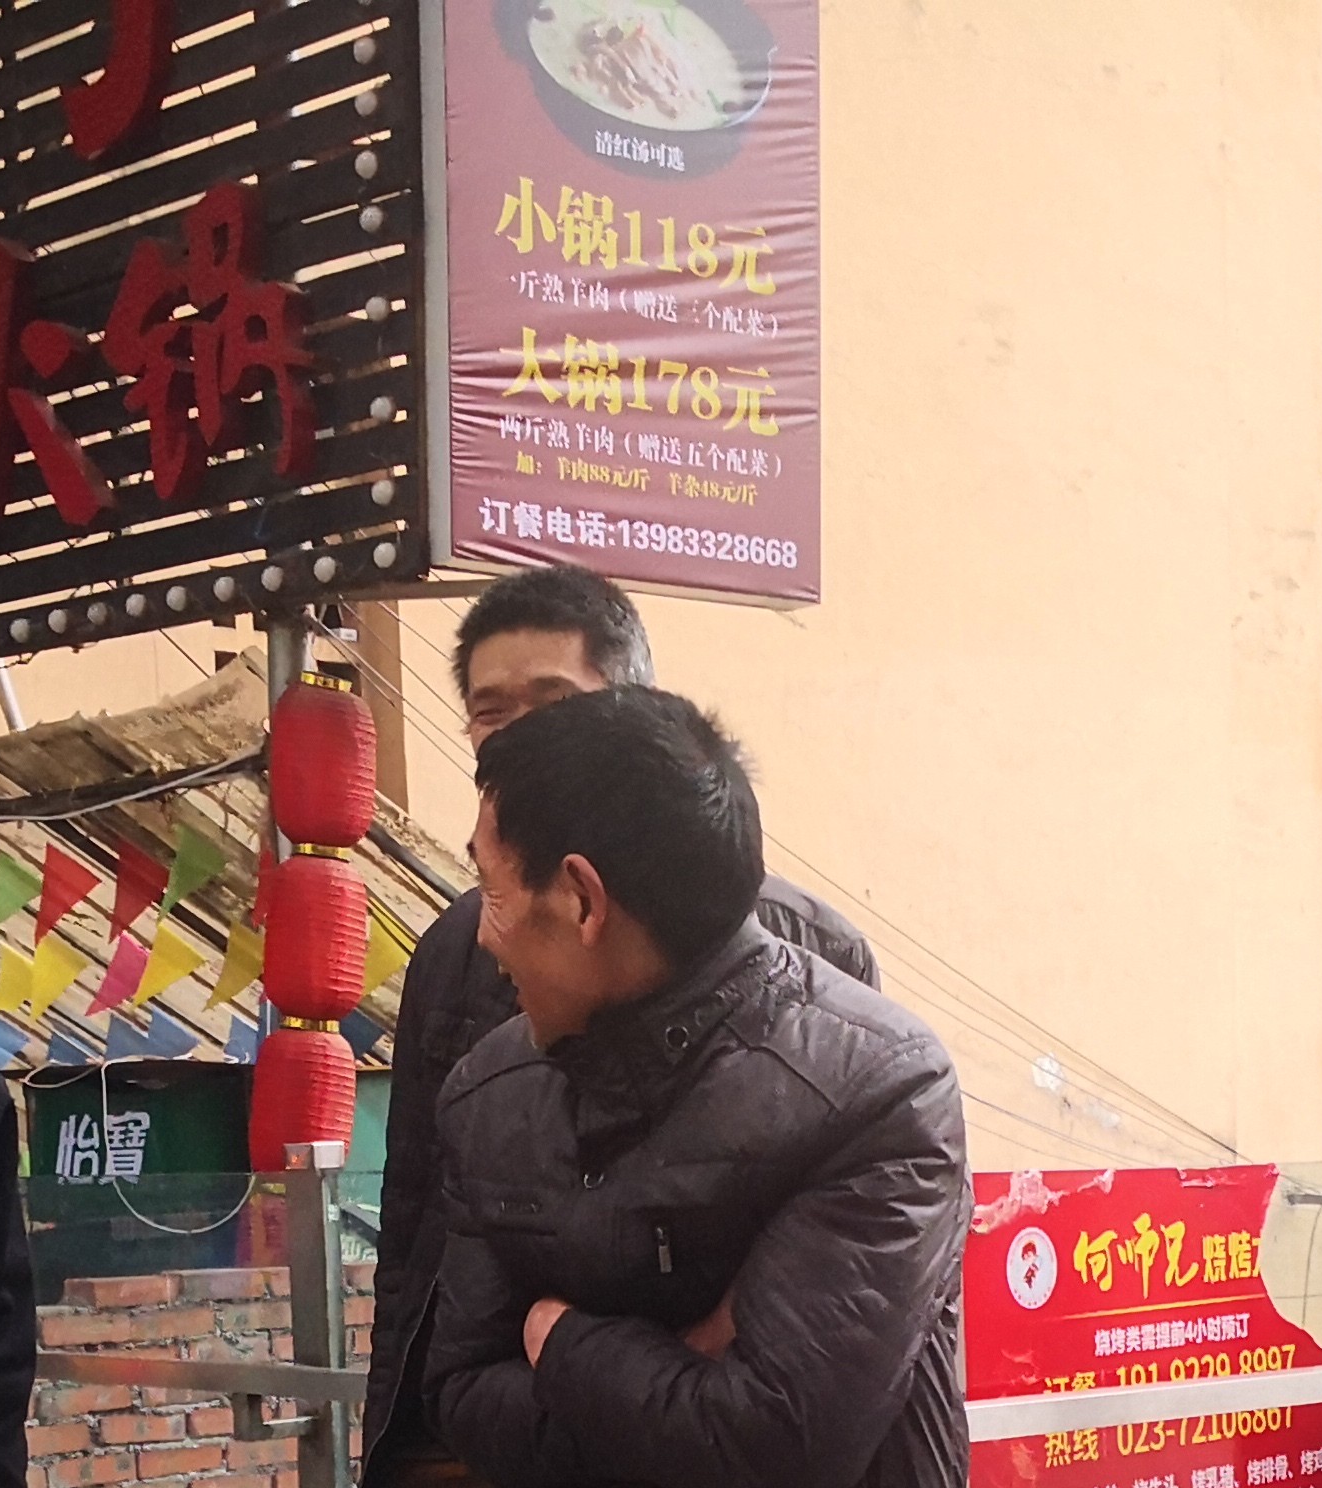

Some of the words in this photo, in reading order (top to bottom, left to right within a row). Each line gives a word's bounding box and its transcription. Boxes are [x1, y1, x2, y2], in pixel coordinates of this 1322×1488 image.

[493, 176, 777, 296] 小锅118元
[499, 326, 780, 437] 大锅178元
[1073, 1212, 1199, 1300] 何师兄
[1044, 1426, 1100, 1469] 热线
